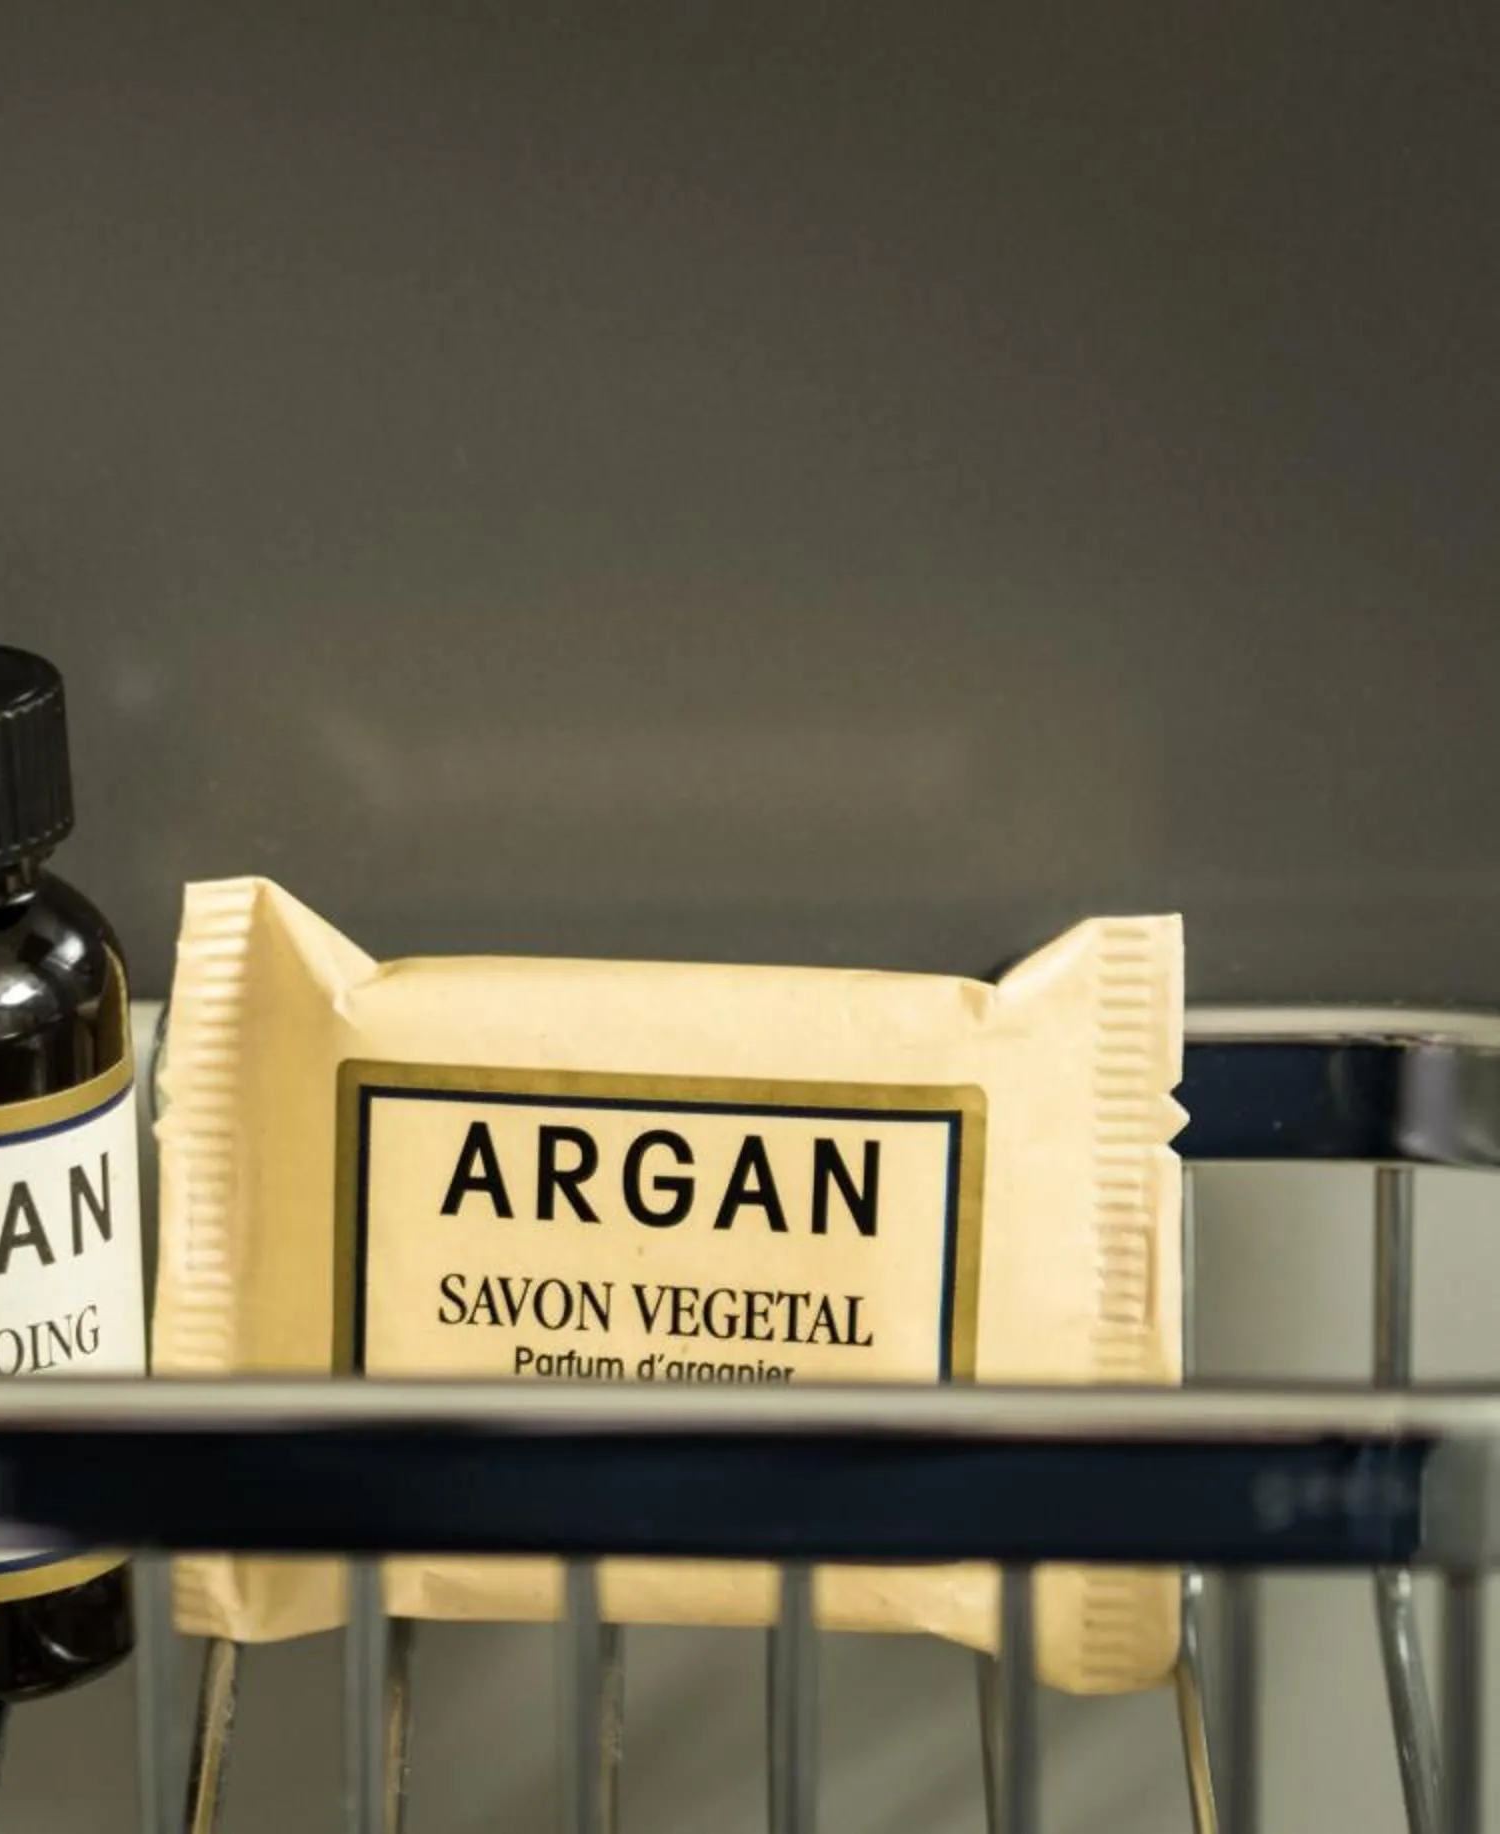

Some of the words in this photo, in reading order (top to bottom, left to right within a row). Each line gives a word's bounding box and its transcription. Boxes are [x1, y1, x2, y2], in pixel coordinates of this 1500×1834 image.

[440, 1120, 881, 1237] ARGAN
[438, 1273, 614, 1332] SAVON
[631, 1283, 874, 1348] VEGETAL
[514, 1345, 625, 1381] Parfum
